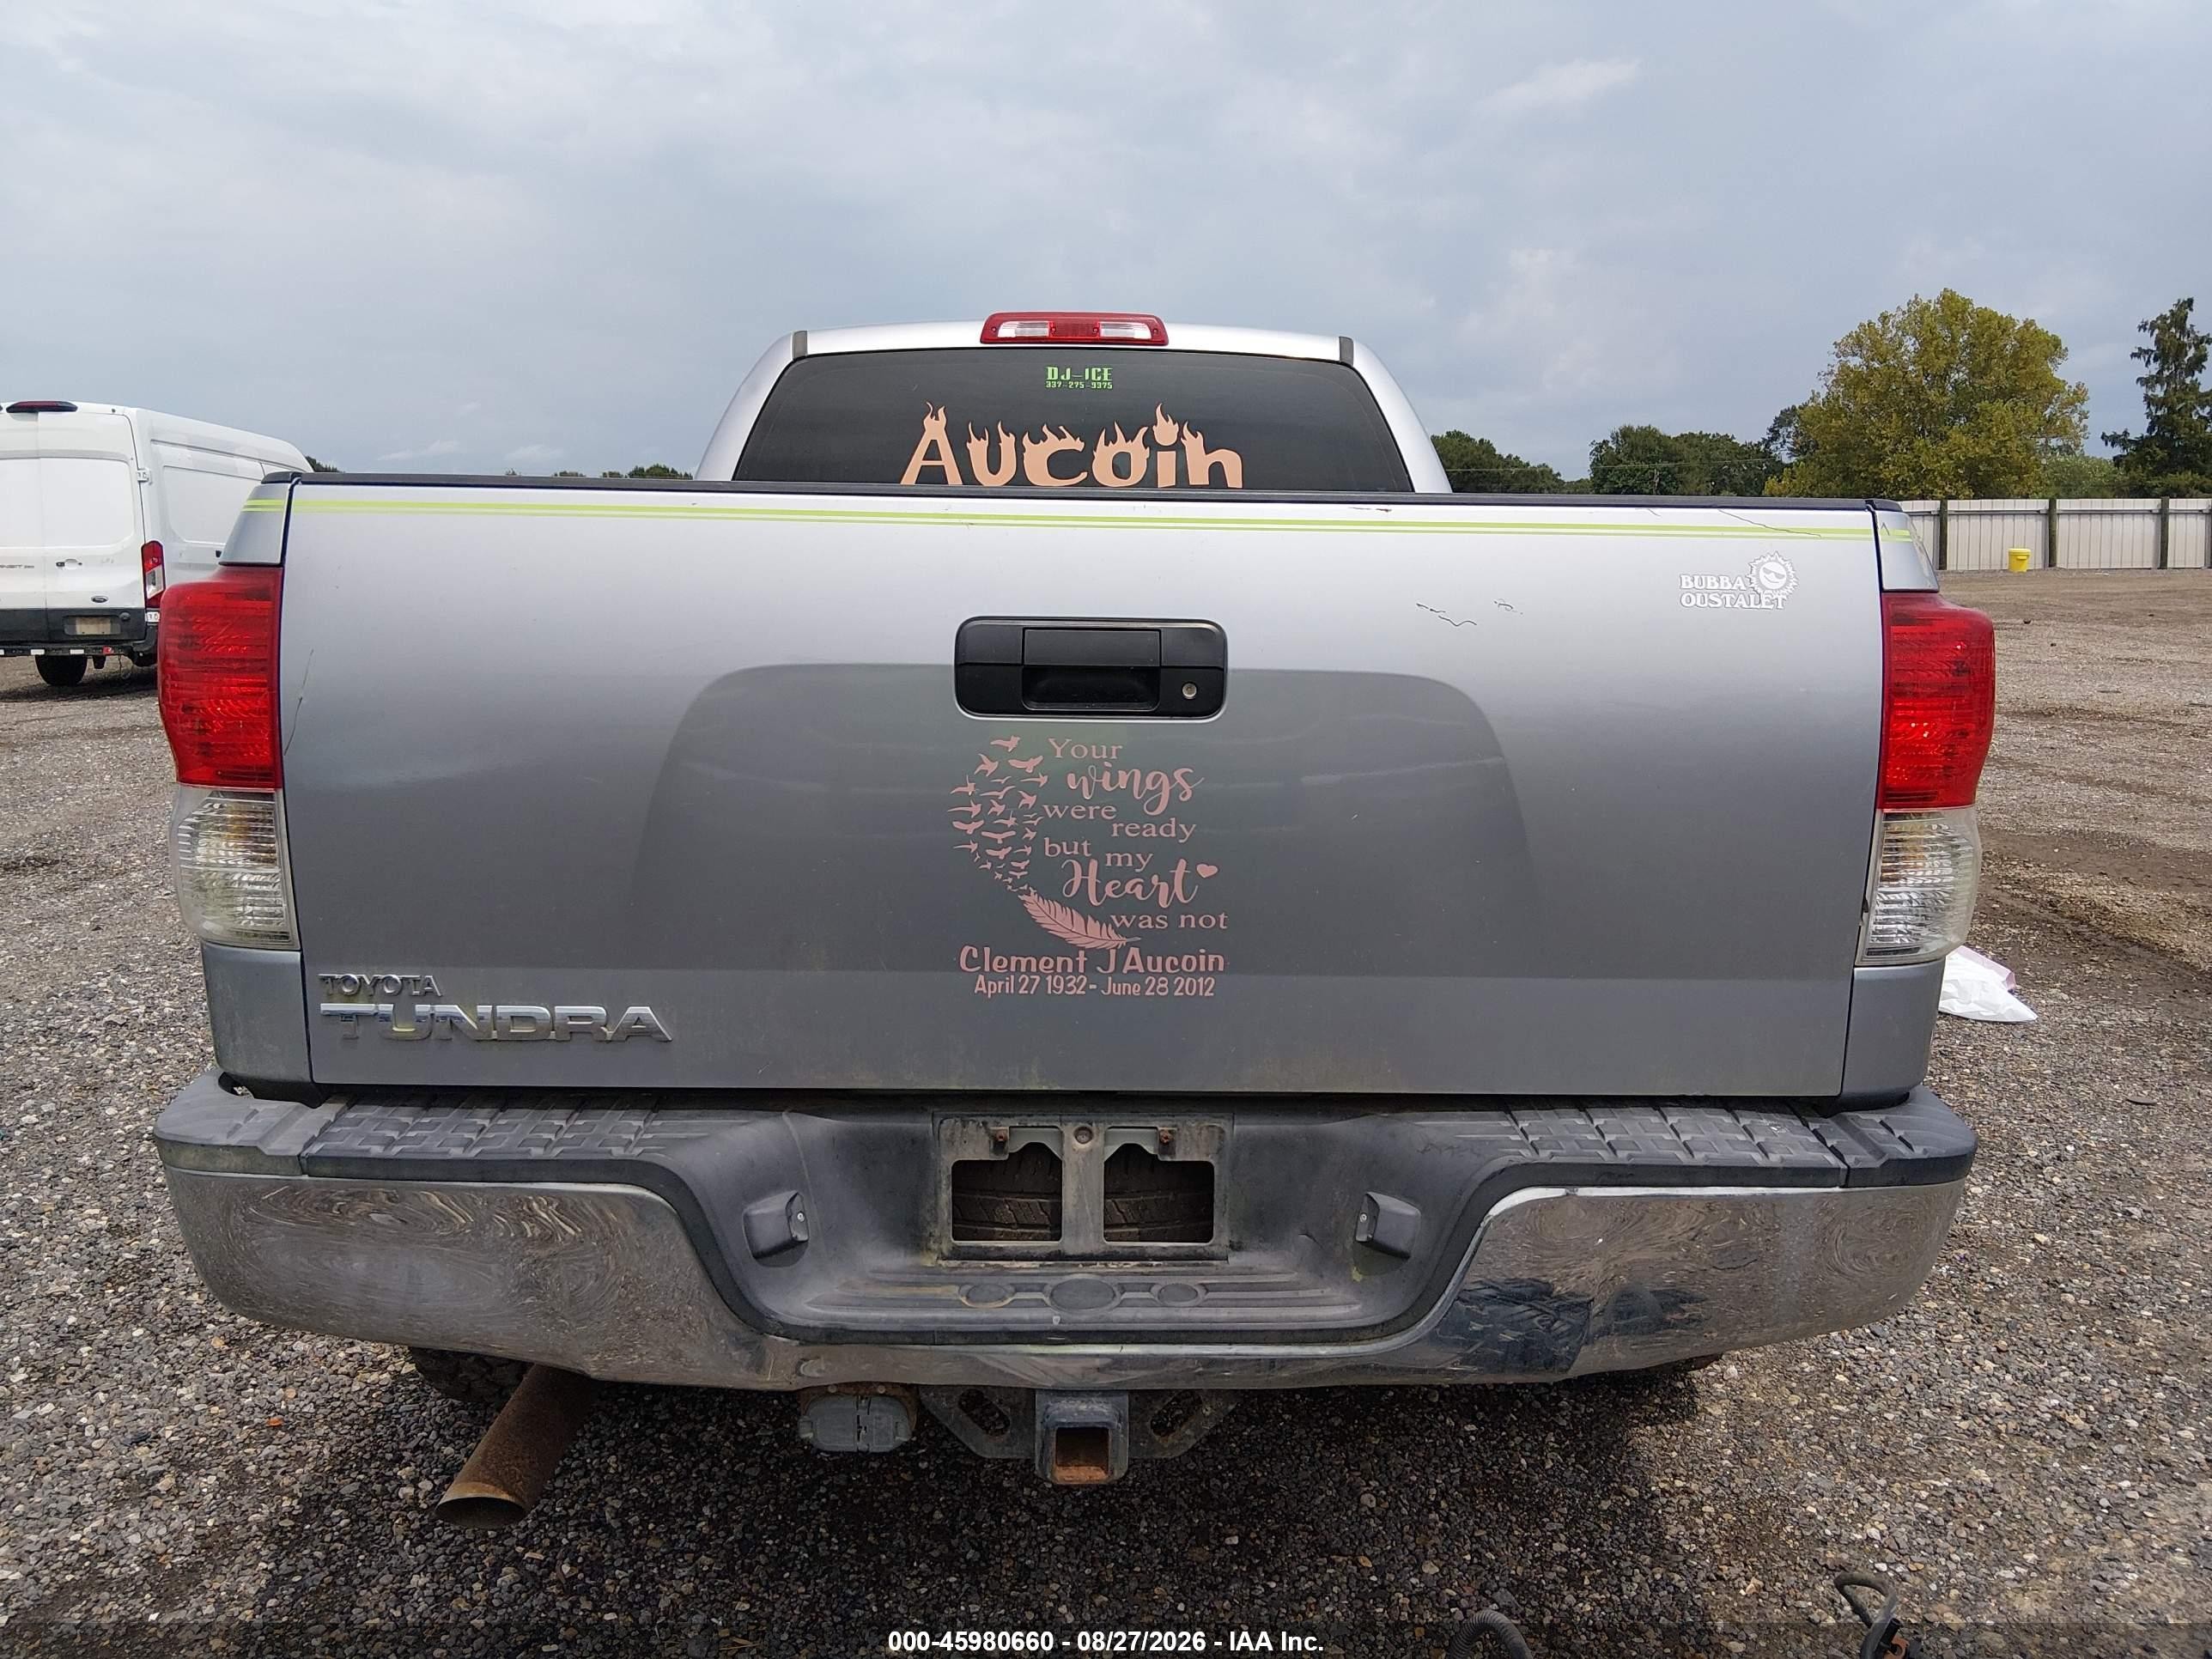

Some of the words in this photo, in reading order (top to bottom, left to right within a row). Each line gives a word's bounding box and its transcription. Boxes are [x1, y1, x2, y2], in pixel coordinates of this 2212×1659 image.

[1680, 574, 1747, 590] BUBBA
[1680, 592, 1784, 610] OUSTALET
[1048, 738, 1123, 758] Your
[1067, 762, 1205, 816] wings
[1043, 804, 1117, 820] were
[1111, 817, 1196, 842] ready
[1044, 837, 1091, 857] but
[1105, 852, 1153, 872] my
[1061, 859, 1199, 908] Heart
[1110, 914, 1168, 929] was
[1178, 912, 1228, 929] not
[959, 945, 1087, 974] Clement
[1097, 947, 1117, 974] J
[1122, 947, 1225, 975] Aucoin
[319, 973, 443, 997] TOYOTA
[975, 975, 1015, 998] April
[1018, 976, 1040, 994] 27
[1100, 976, 1141, 996] June
[1146, 977, 1169, 995] 28
[1174, 977, 1216, 996] 2012
[320, 1003, 672, 1042] TUNDRA
